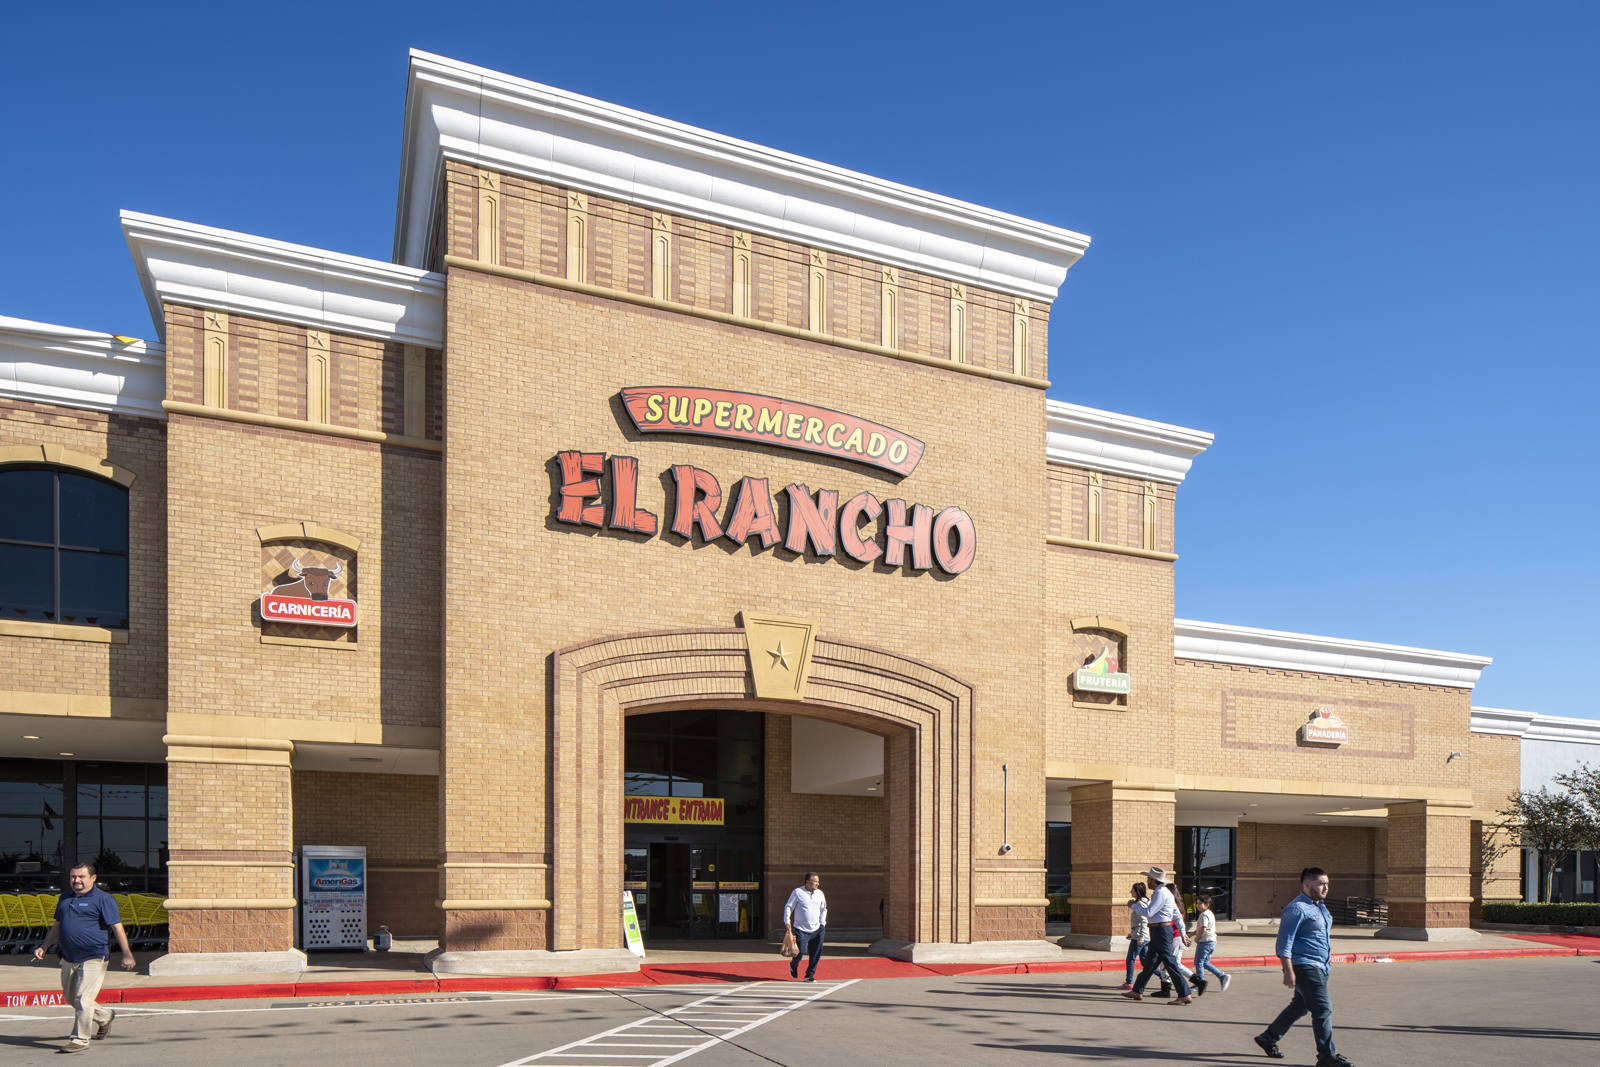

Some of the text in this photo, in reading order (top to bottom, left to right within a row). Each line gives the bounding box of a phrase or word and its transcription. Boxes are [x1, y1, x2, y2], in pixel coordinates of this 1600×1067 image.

[645, 394, 909, 465] SUPERMERCADO
[556, 450, 977, 576] EL RANCHO
[268, 601, 351, 619] CARNICERÍA
[1080, 675, 1127, 689] FRUTERÍA
[624, 797, 723, 823] NTRANCE ENTRADA
[6, 993, 63, 1007] TOW AWAY
